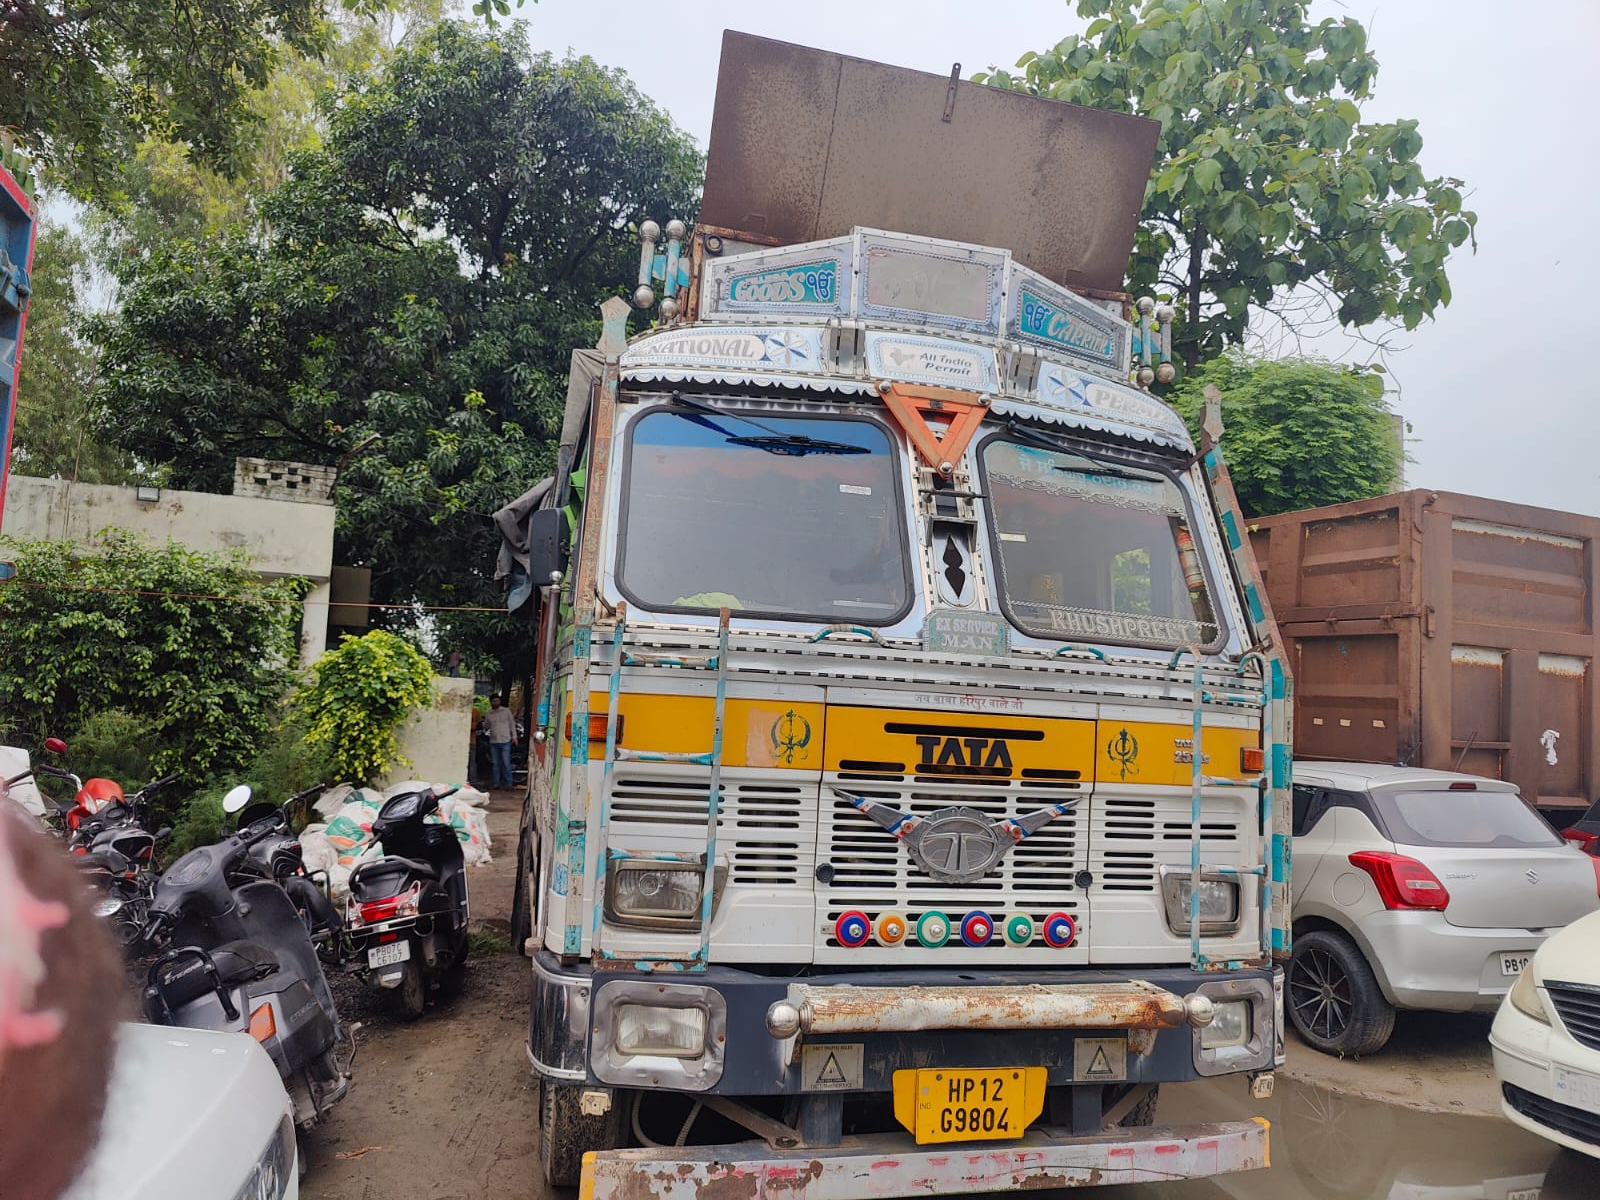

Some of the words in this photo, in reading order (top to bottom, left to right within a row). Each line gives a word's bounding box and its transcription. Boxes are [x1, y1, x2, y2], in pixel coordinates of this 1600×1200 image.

[735, 271, 805, 301] GOODS
[652, 337, 755, 359] NATIONAL
[920, 352, 937, 361] All
[925, 362, 971, 376] Permit
[953, 618, 999, 635] SERVICE
[941, 633, 994, 649] MAN
[915, 735, 1013, 768] TATA
[948, 1077, 1003, 1103] HP12
[940, 1107, 1009, 1133] G9804
